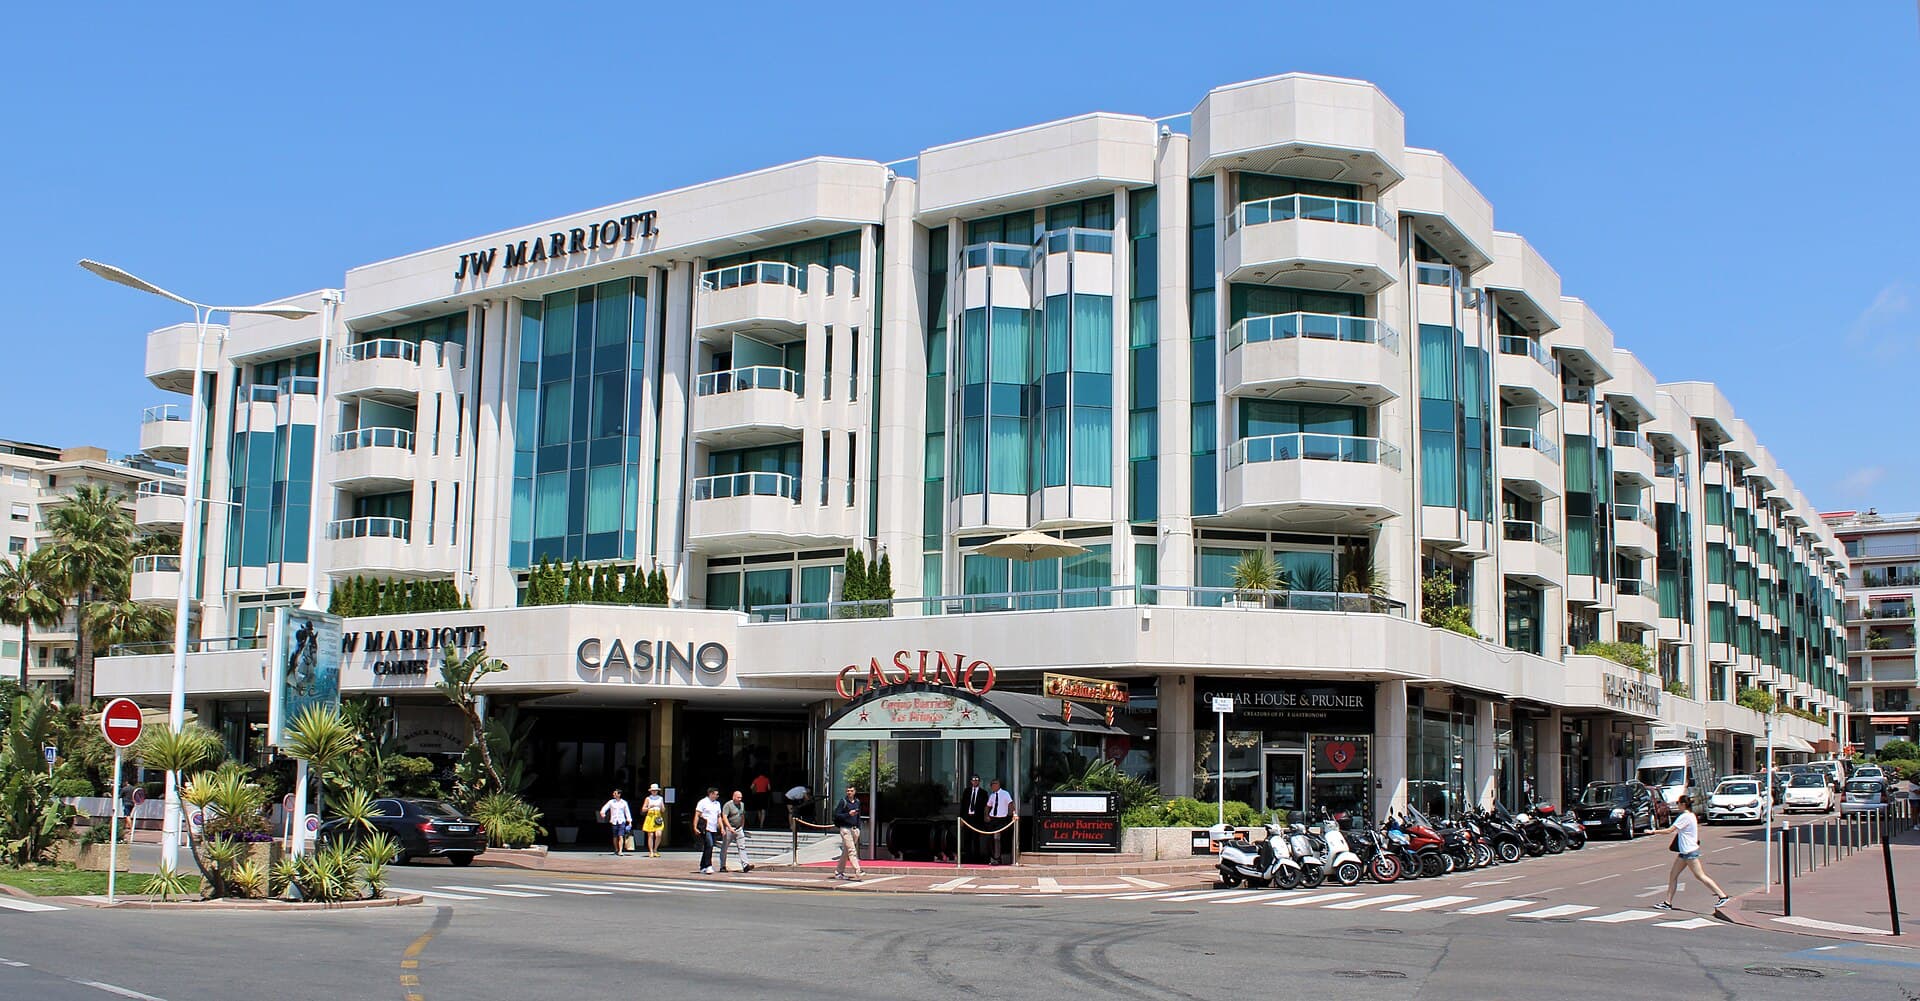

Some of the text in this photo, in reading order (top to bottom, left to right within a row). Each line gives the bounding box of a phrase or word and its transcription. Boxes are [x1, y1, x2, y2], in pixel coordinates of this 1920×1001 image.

[455, 248, 497, 280] JW
[342, 632, 360, 653] W
[577, 637, 729, 673] CASINO
[373, 659, 429, 676] CANNES
[835, 649, 997, 700] CASINO
[1255, 693, 1297, 706] HOUSE
[1299, 694, 1310, 706] &
[1311, 694, 1364, 708] PRUNIER
[1043, 819, 1114, 830] Casino Barrière
[1054, 830, 1105, 840] Les Princes
